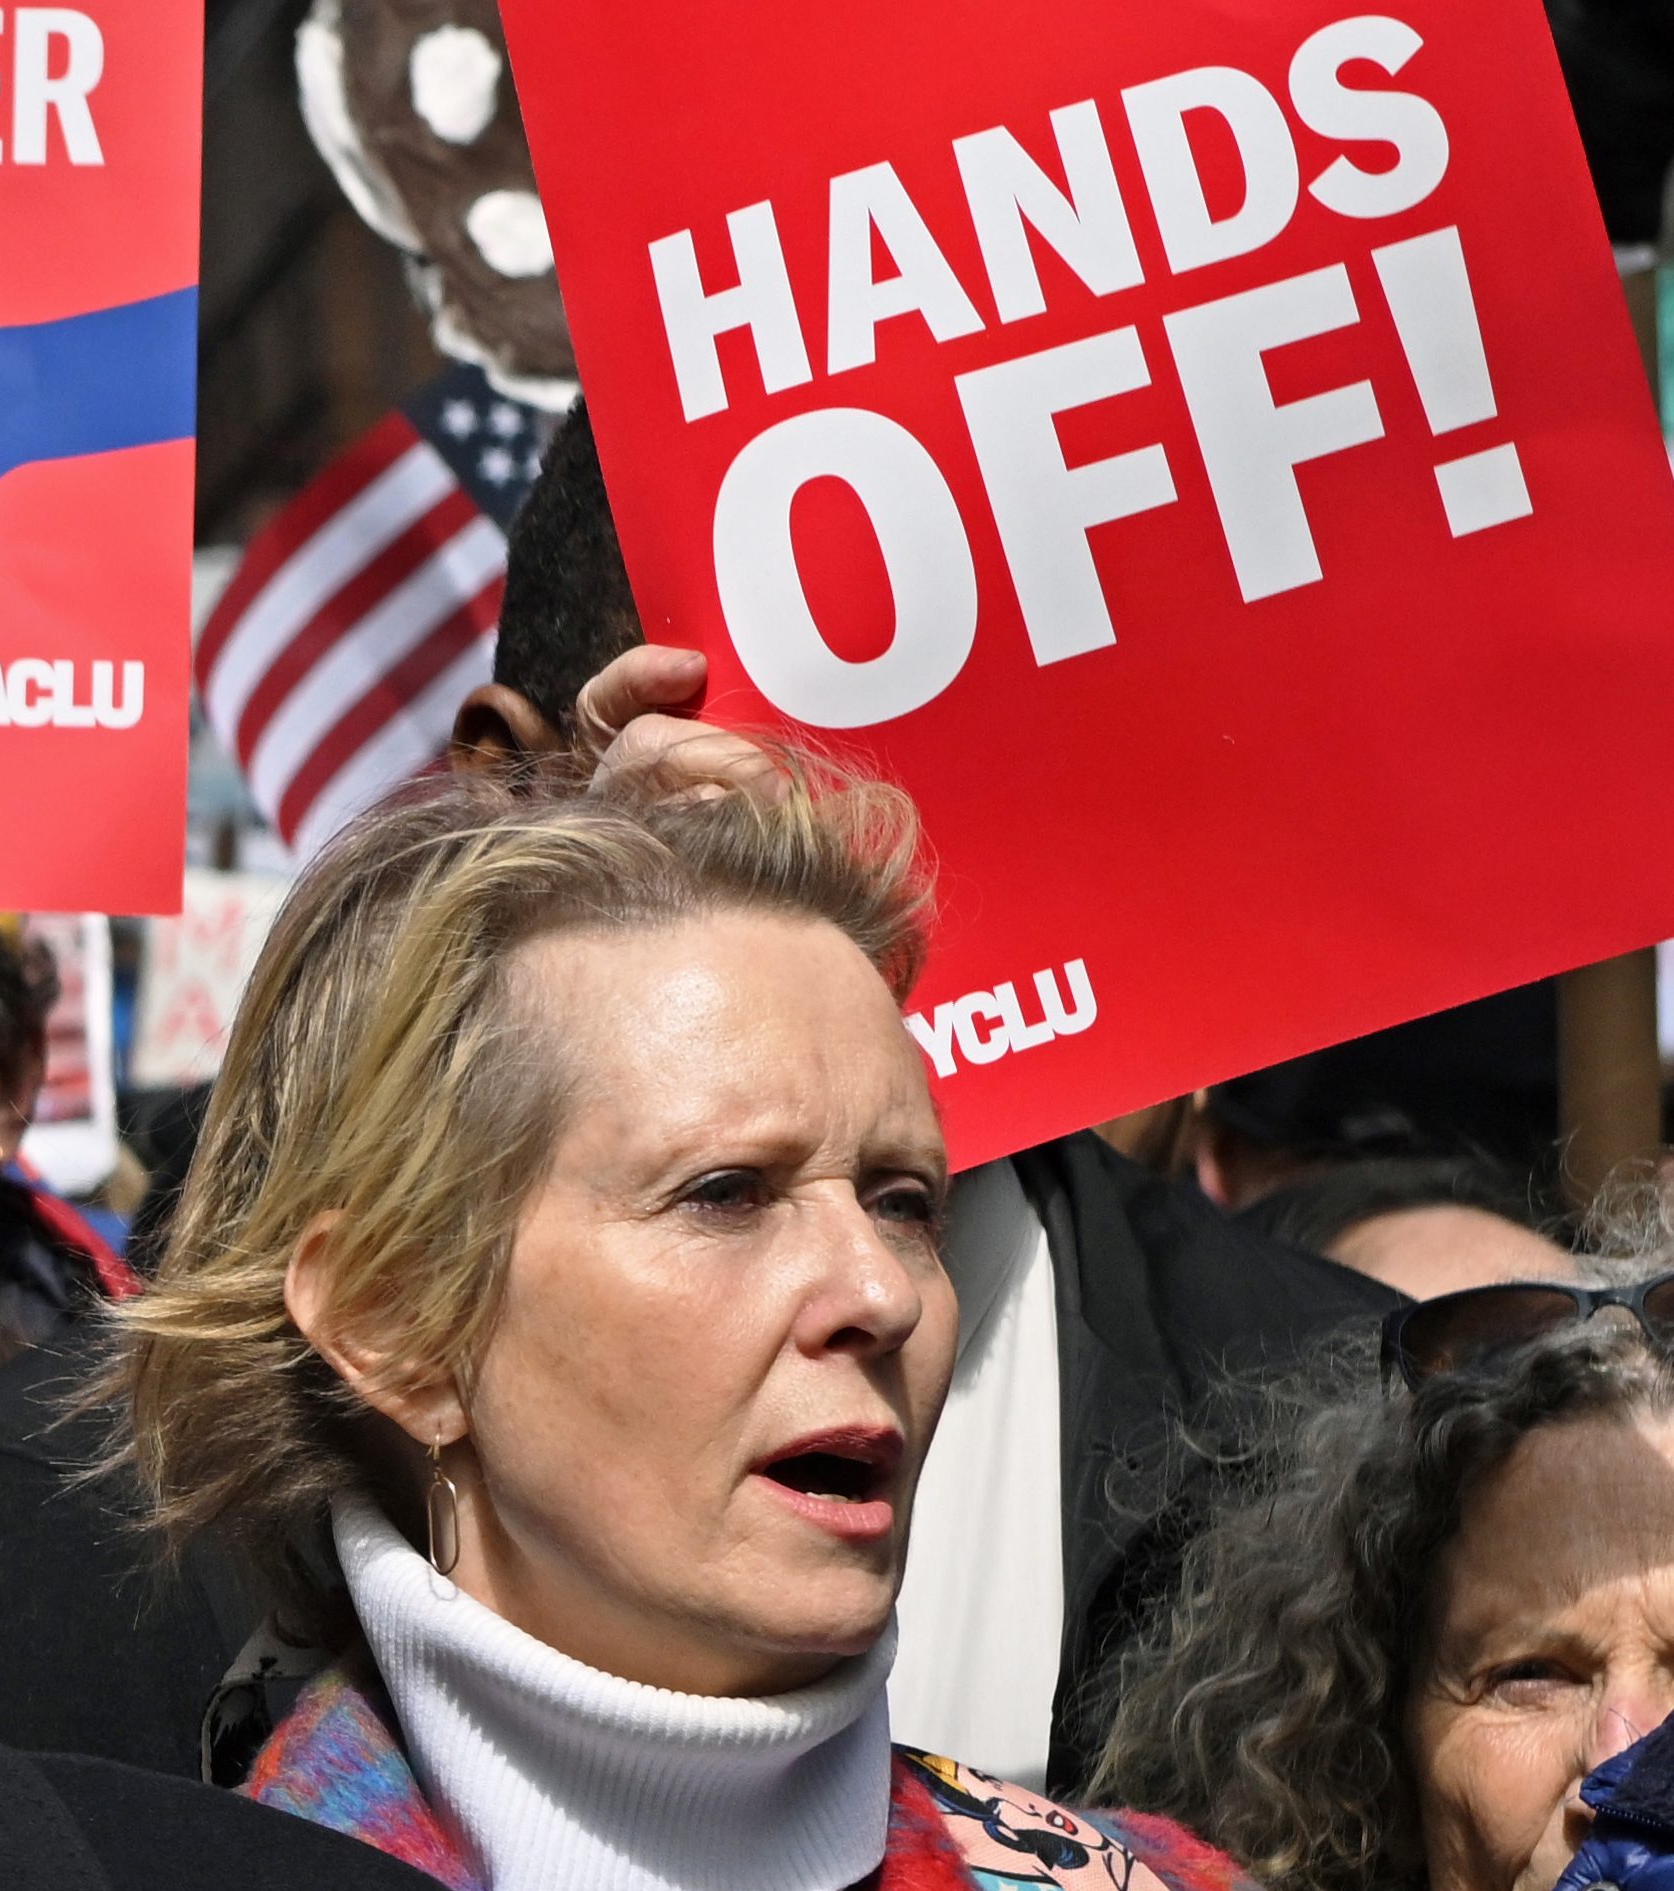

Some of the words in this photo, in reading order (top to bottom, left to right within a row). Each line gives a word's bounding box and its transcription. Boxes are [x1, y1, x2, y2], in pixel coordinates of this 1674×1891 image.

[648, 15, 1450, 423] HANDS
[713, 225, 1535, 729] OFF!
[902, 957, 1098, 1080] YCLU
